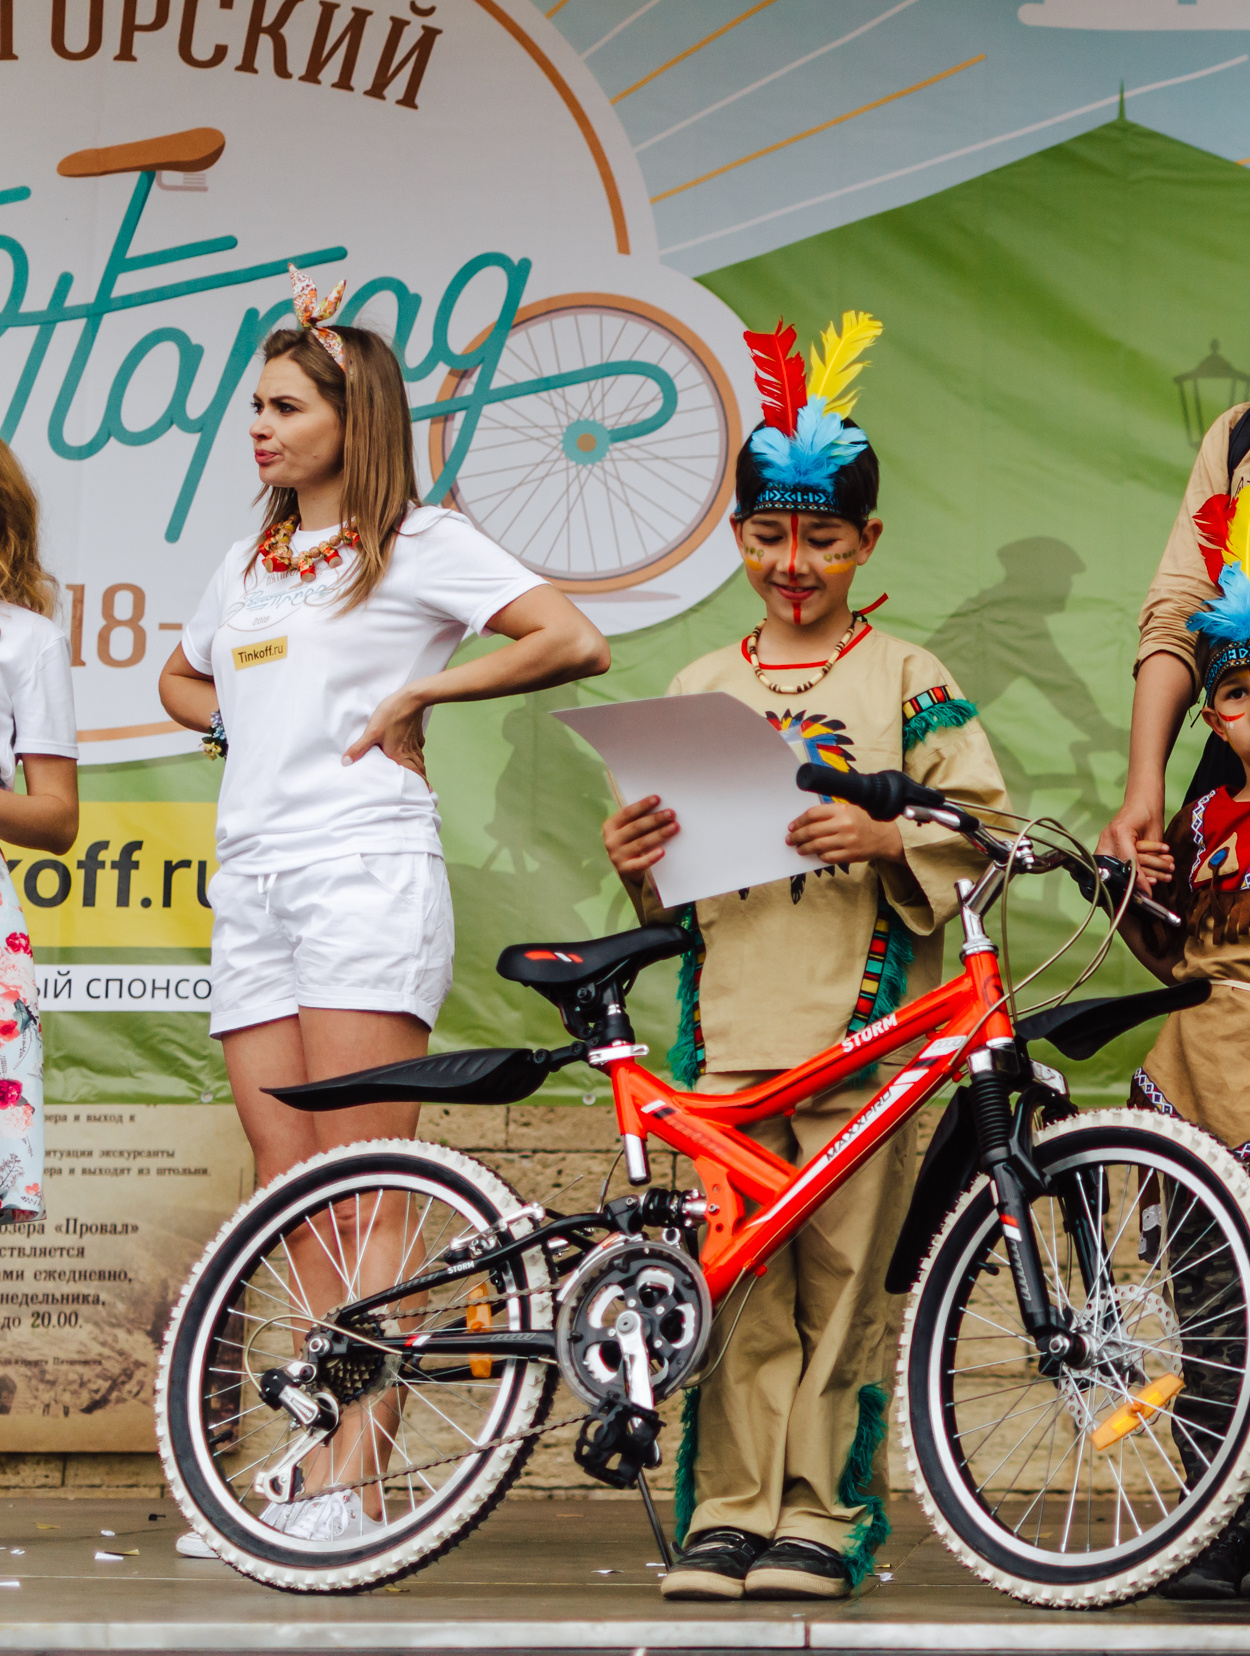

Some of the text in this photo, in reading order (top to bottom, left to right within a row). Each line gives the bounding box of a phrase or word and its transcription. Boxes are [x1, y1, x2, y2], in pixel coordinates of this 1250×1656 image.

[237, 644, 284, 664] Tinkoff.ru
[8, 840, 213, 909] off.ru
[841, 1013, 898, 1053] STORM
[86, 1113, 124, 1124] выход
[826, 1088, 892, 1162] MAXXPRO
[54, 1218, 140, 1239] «Провал»
[33, 1269, 133, 1284] ежедневно,
[447, 1260, 475, 1274] STORM
[1, 1317, 21, 1330] до
